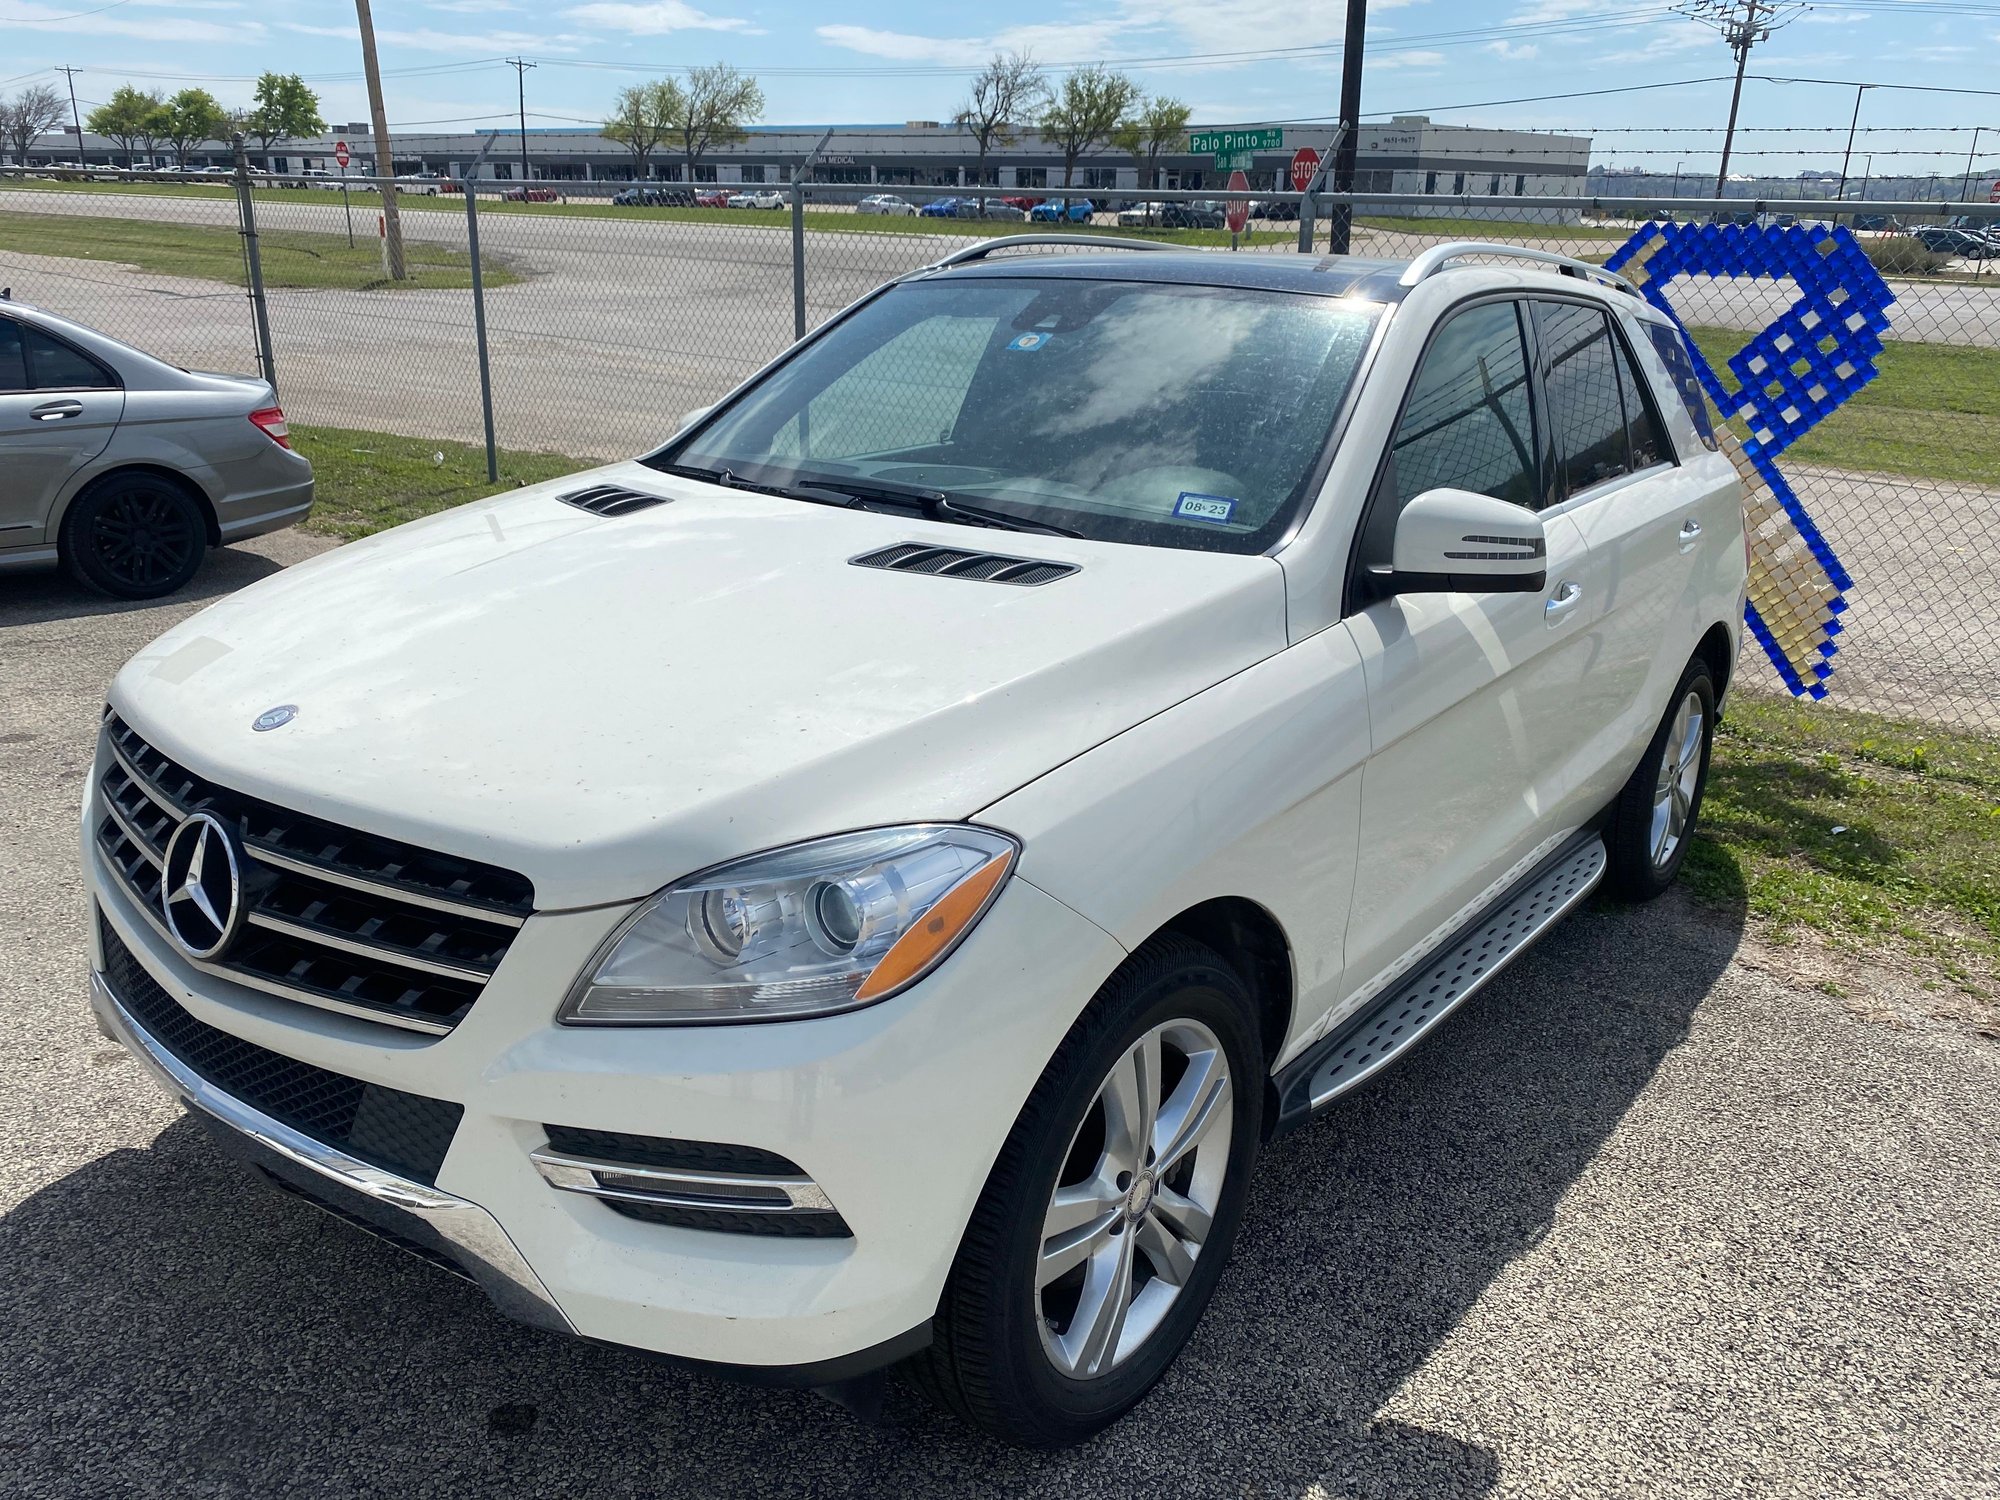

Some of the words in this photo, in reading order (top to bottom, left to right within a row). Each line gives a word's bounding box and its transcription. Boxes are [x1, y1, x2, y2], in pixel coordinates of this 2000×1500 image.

[1193, 137, 1219, 152] Palo
[1224, 133, 1257, 149] Pinto
[1262, 138, 1280, 148] 9700
[828, 155, 855, 164] MEDICAL
[1217, 153, 1227, 168] San
[1293, 161, 1319, 179] STOP
[1228, 200, 1247, 214] STOP
[1185, 502, 1202, 512] 08
[1208, 505, 1226, 515] 23
